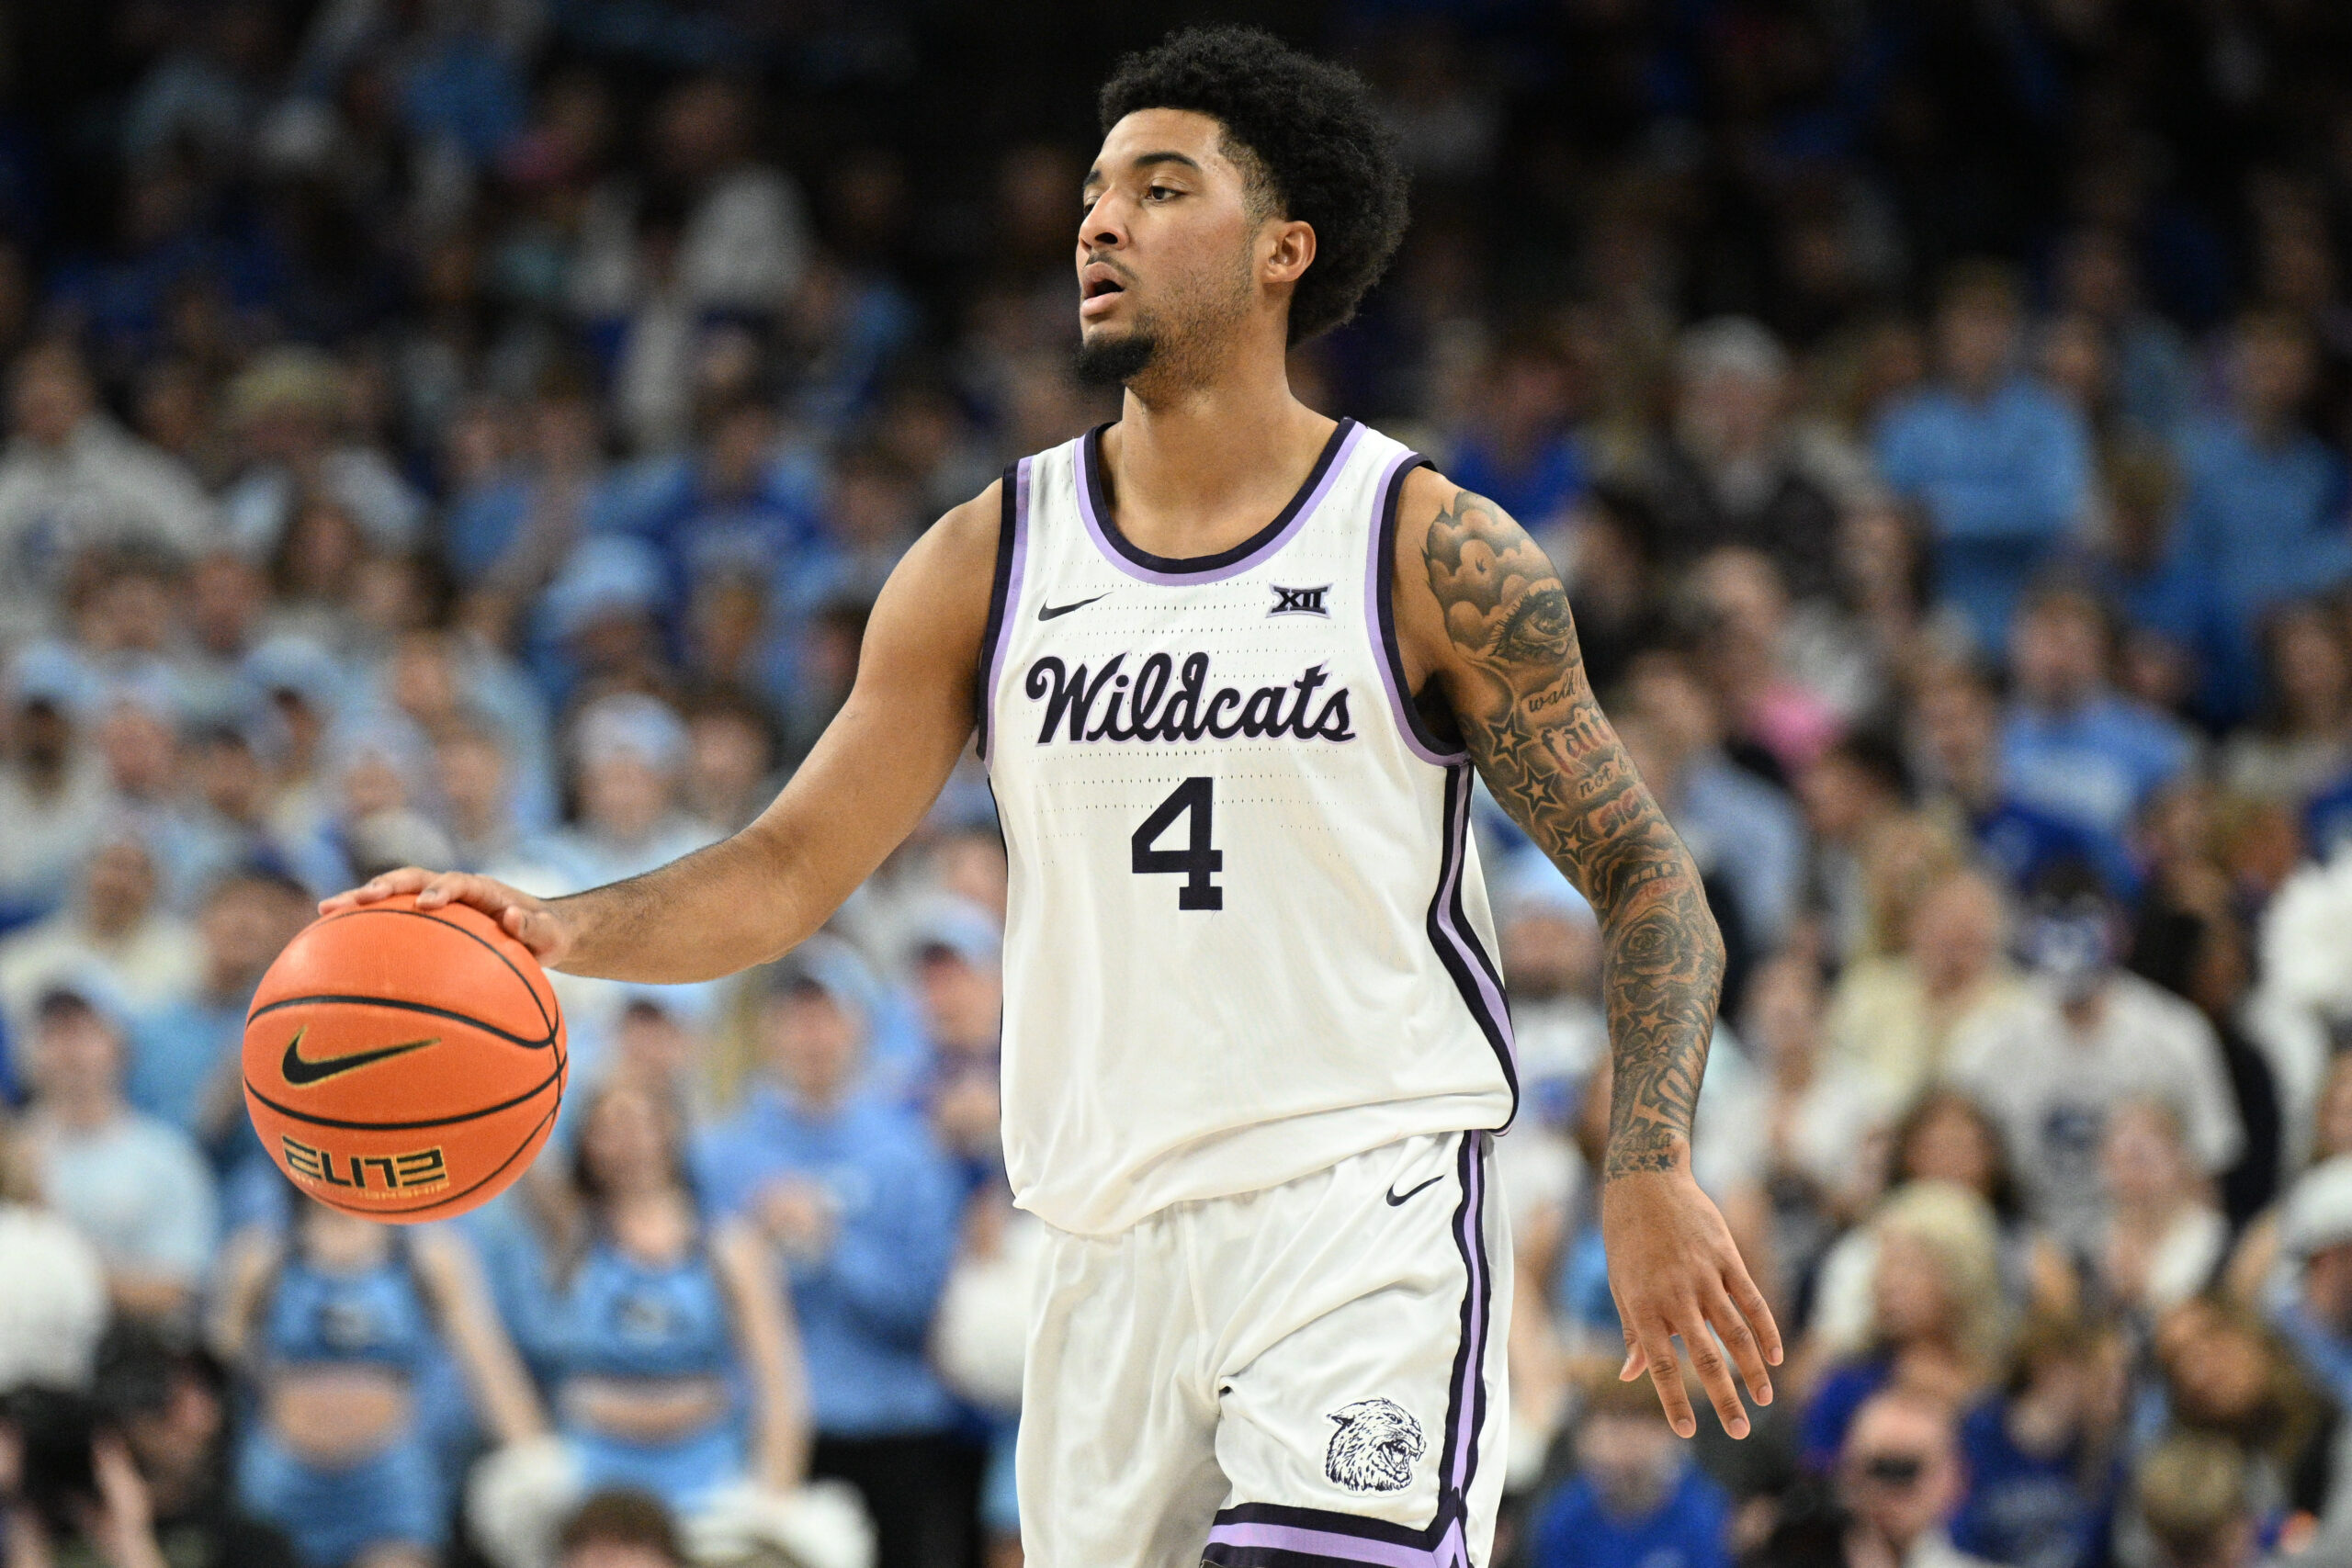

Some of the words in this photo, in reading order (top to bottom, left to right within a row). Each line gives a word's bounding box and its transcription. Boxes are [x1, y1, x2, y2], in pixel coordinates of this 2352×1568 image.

[1268, 584, 1331, 616] XII
[1024, 651, 1356, 747] Wildcats
[1131, 777, 1223, 910] 4
[281, 1134, 447, 1188] ELITE
